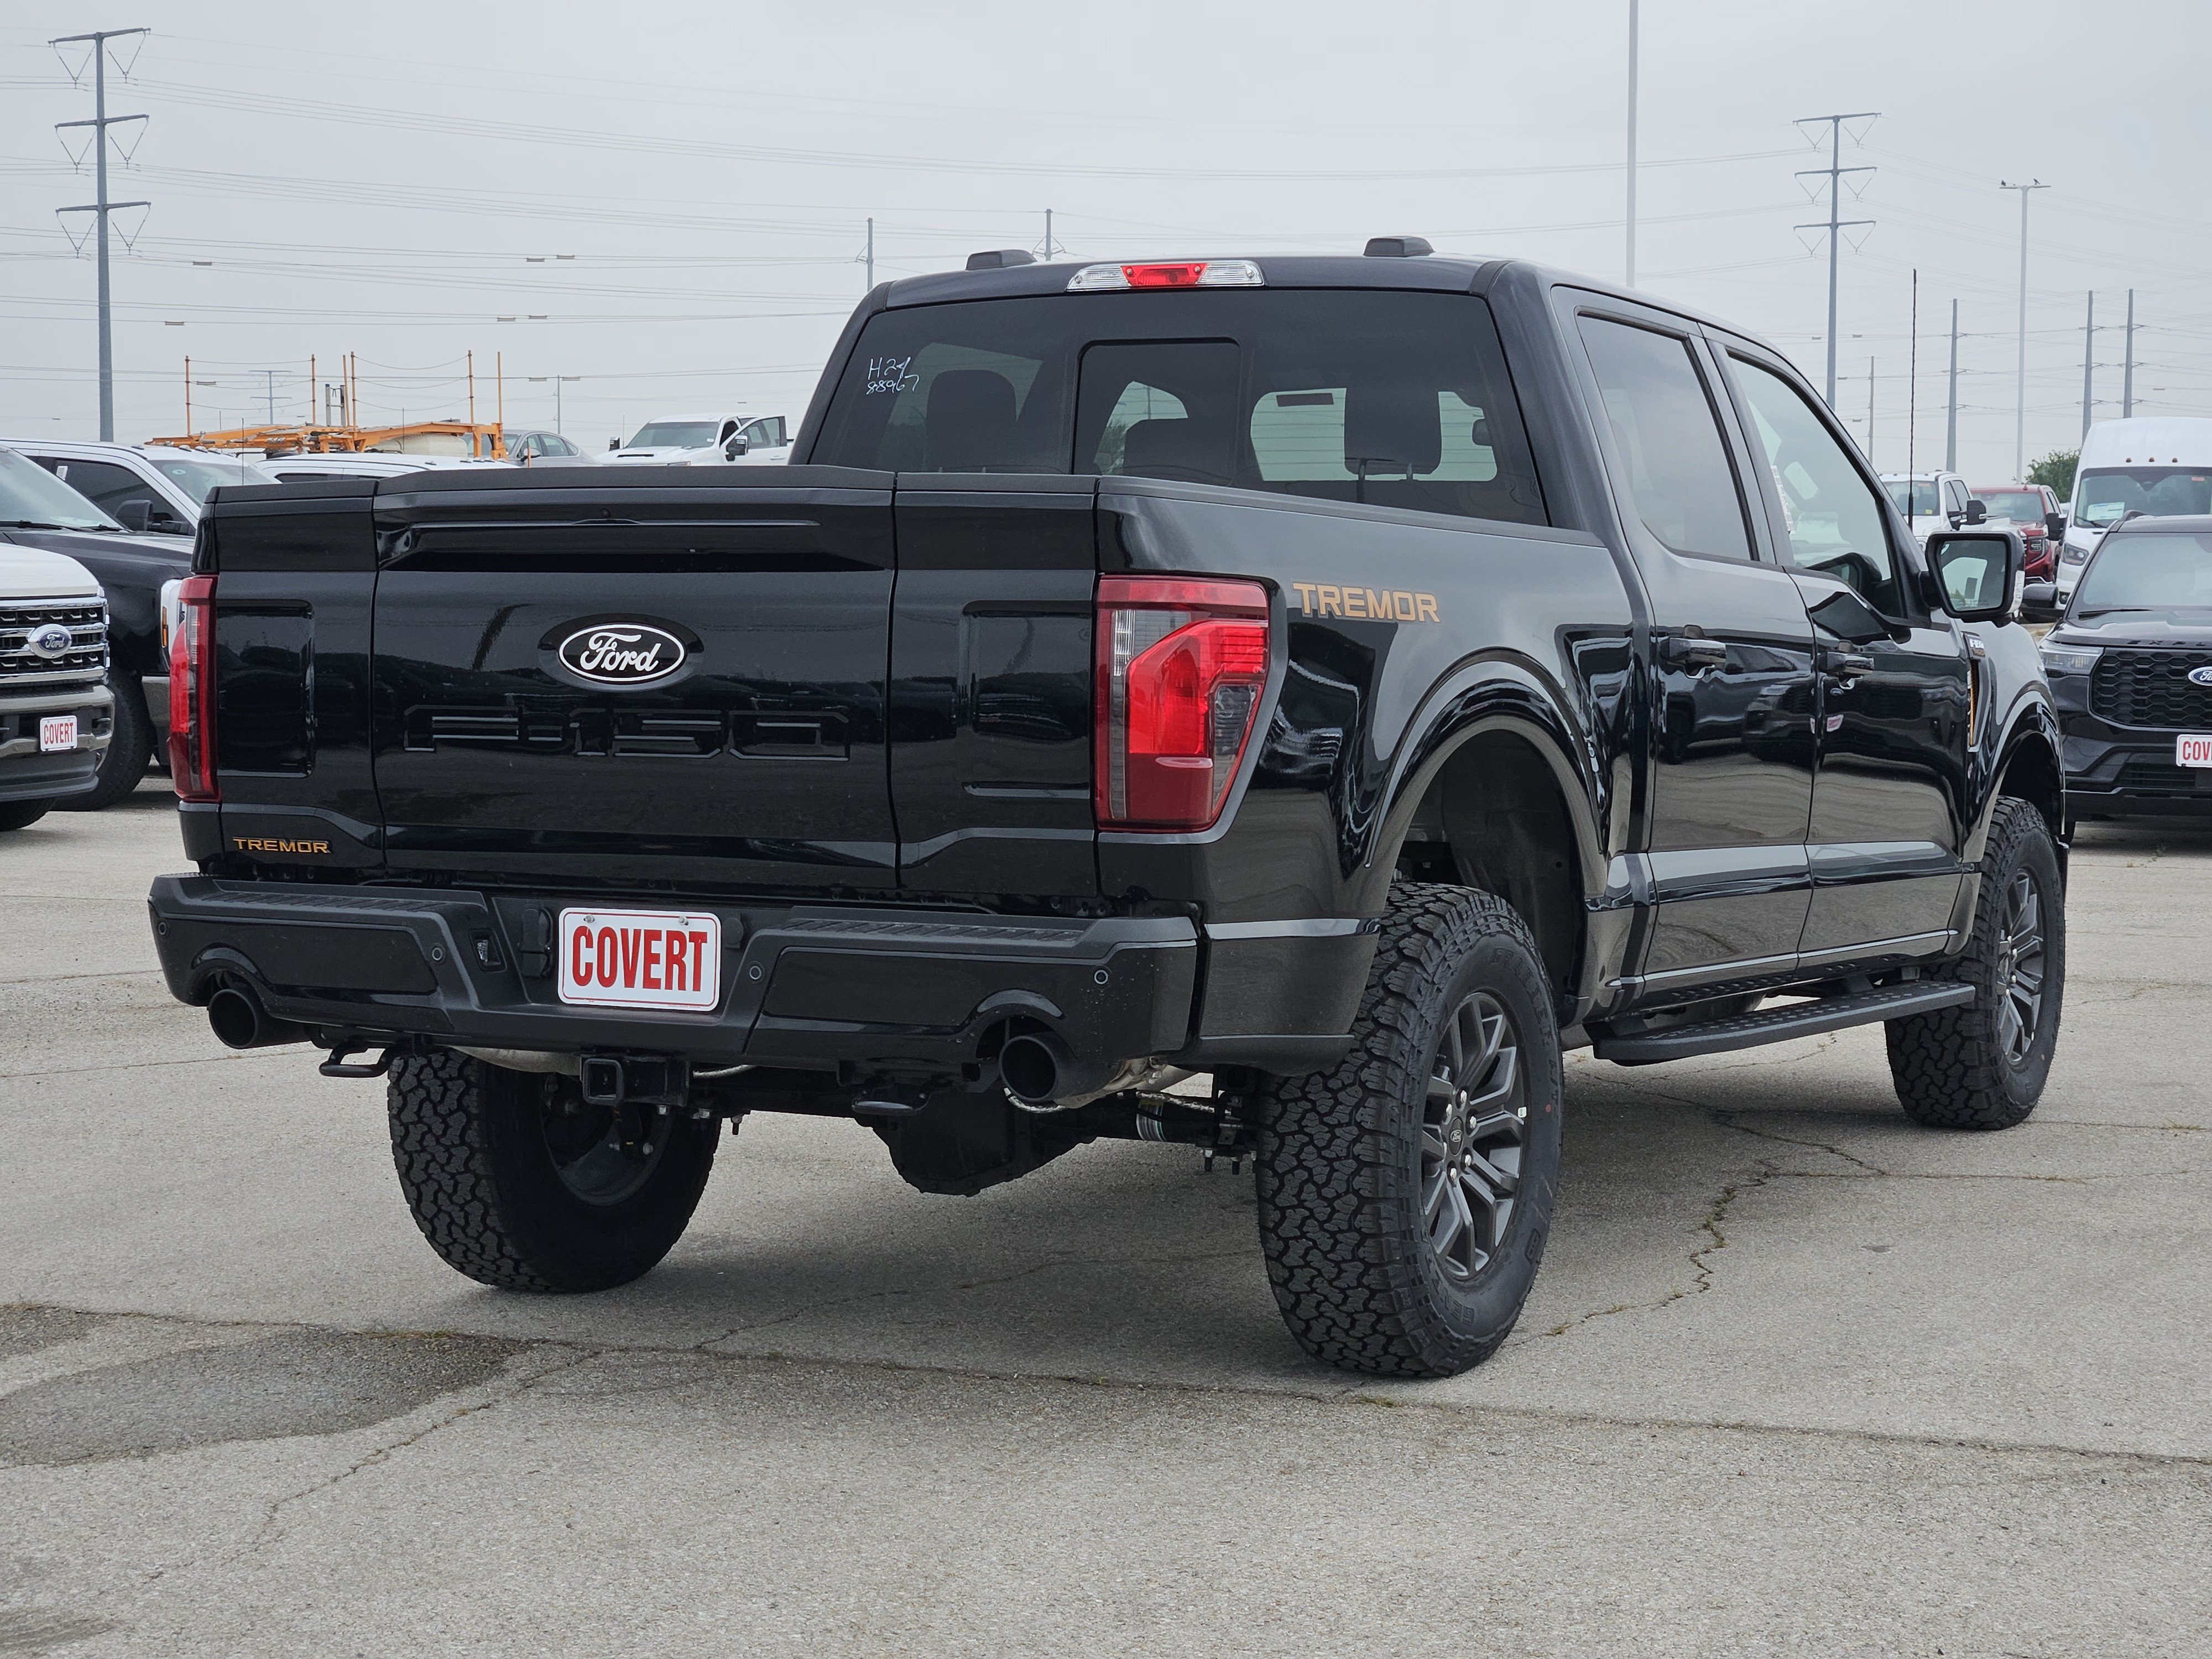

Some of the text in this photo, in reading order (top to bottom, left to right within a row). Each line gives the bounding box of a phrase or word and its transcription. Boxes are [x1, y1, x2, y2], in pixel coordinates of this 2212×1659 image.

[868, 356, 911, 380] H24
[1292, 582, 1440, 622] TREMOR
[45, 633, 65, 648] Ford
[580, 632, 661, 672] Ford
[44, 722, 74, 745] COVERT
[404, 704, 851, 761] F-150
[2183, 740, 2212, 761] COV
[232, 836, 331, 854] TREMOR
[572, 925, 708, 992] COVERT
